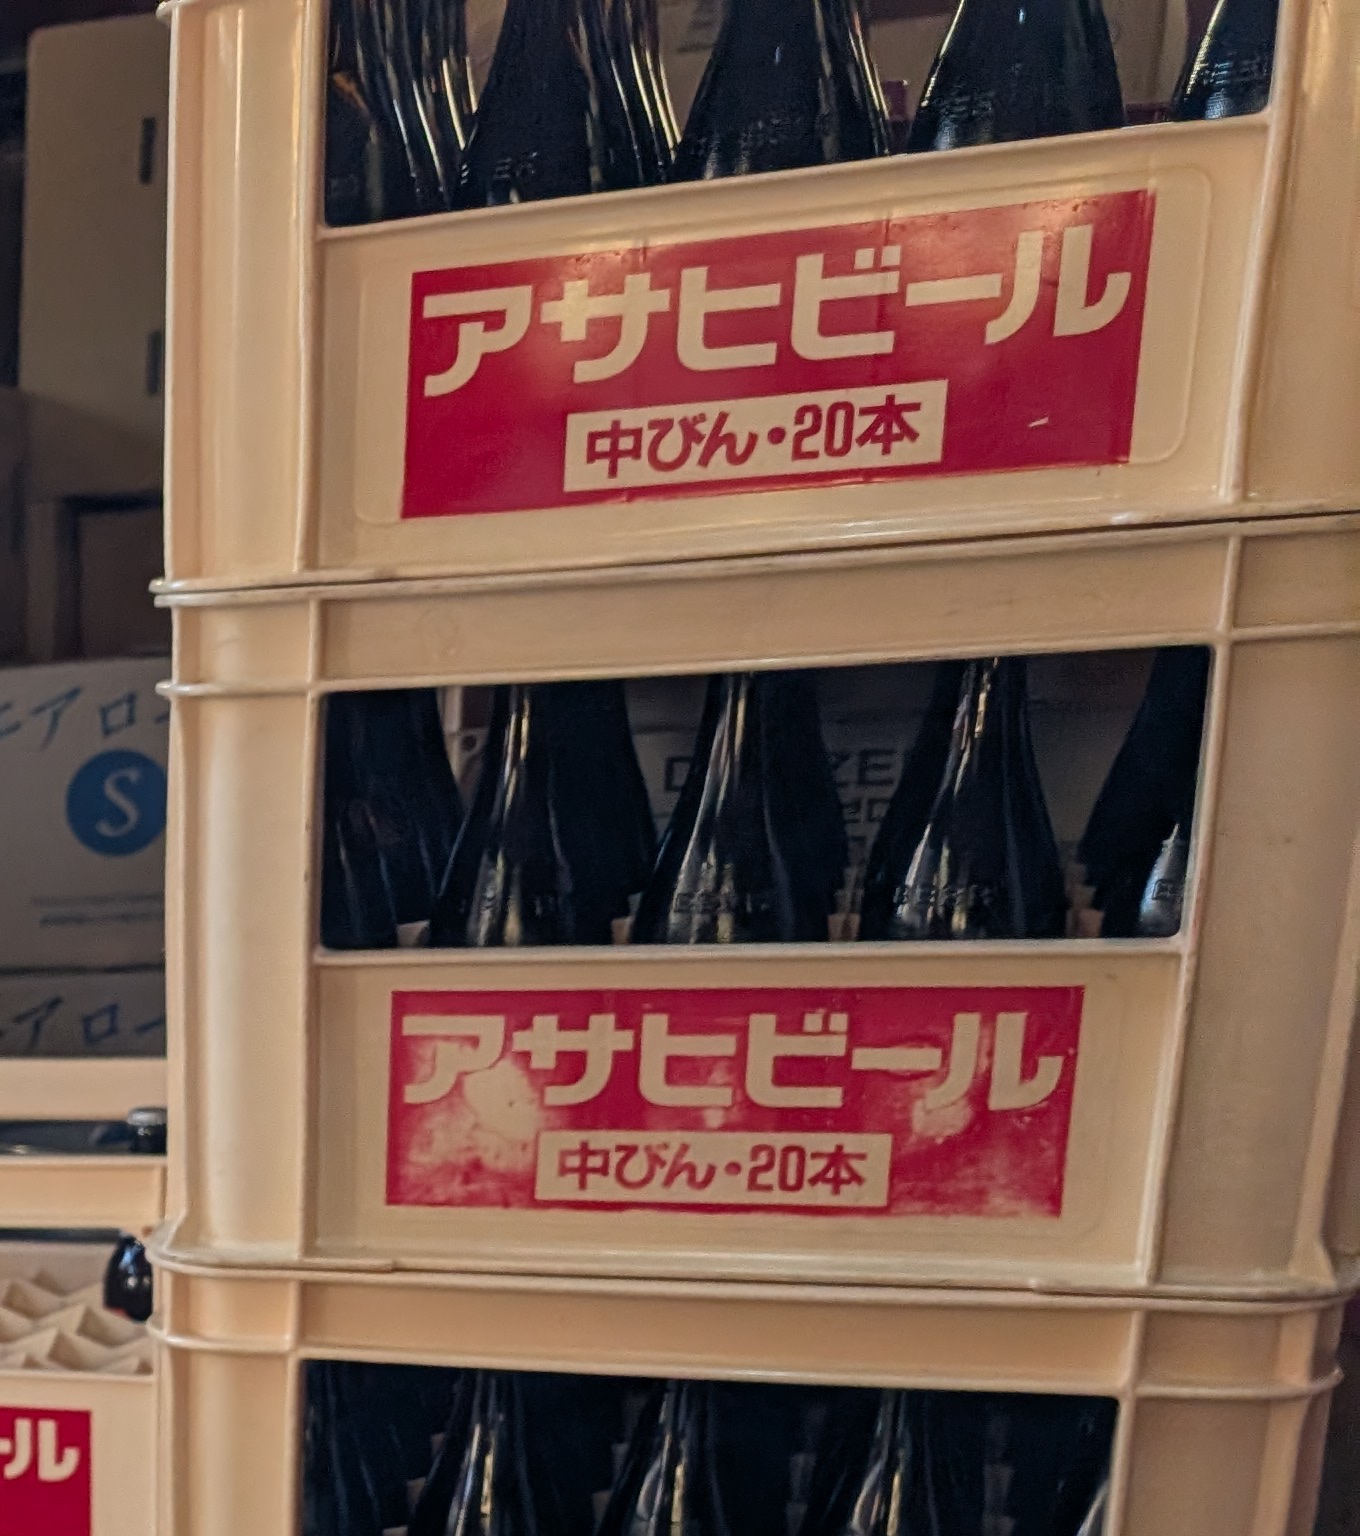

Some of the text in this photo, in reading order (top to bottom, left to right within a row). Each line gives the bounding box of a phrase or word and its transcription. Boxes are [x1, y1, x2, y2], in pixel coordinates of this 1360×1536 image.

[422, 223, 1132, 397] アサヒビール
[585, 393, 920, 479] 中びん・20本
[94, 766, 142, 839] S
[401, 1011, 1067, 1112] アサヒビール
[556, 1140, 868, 1197] 中びん・20本
